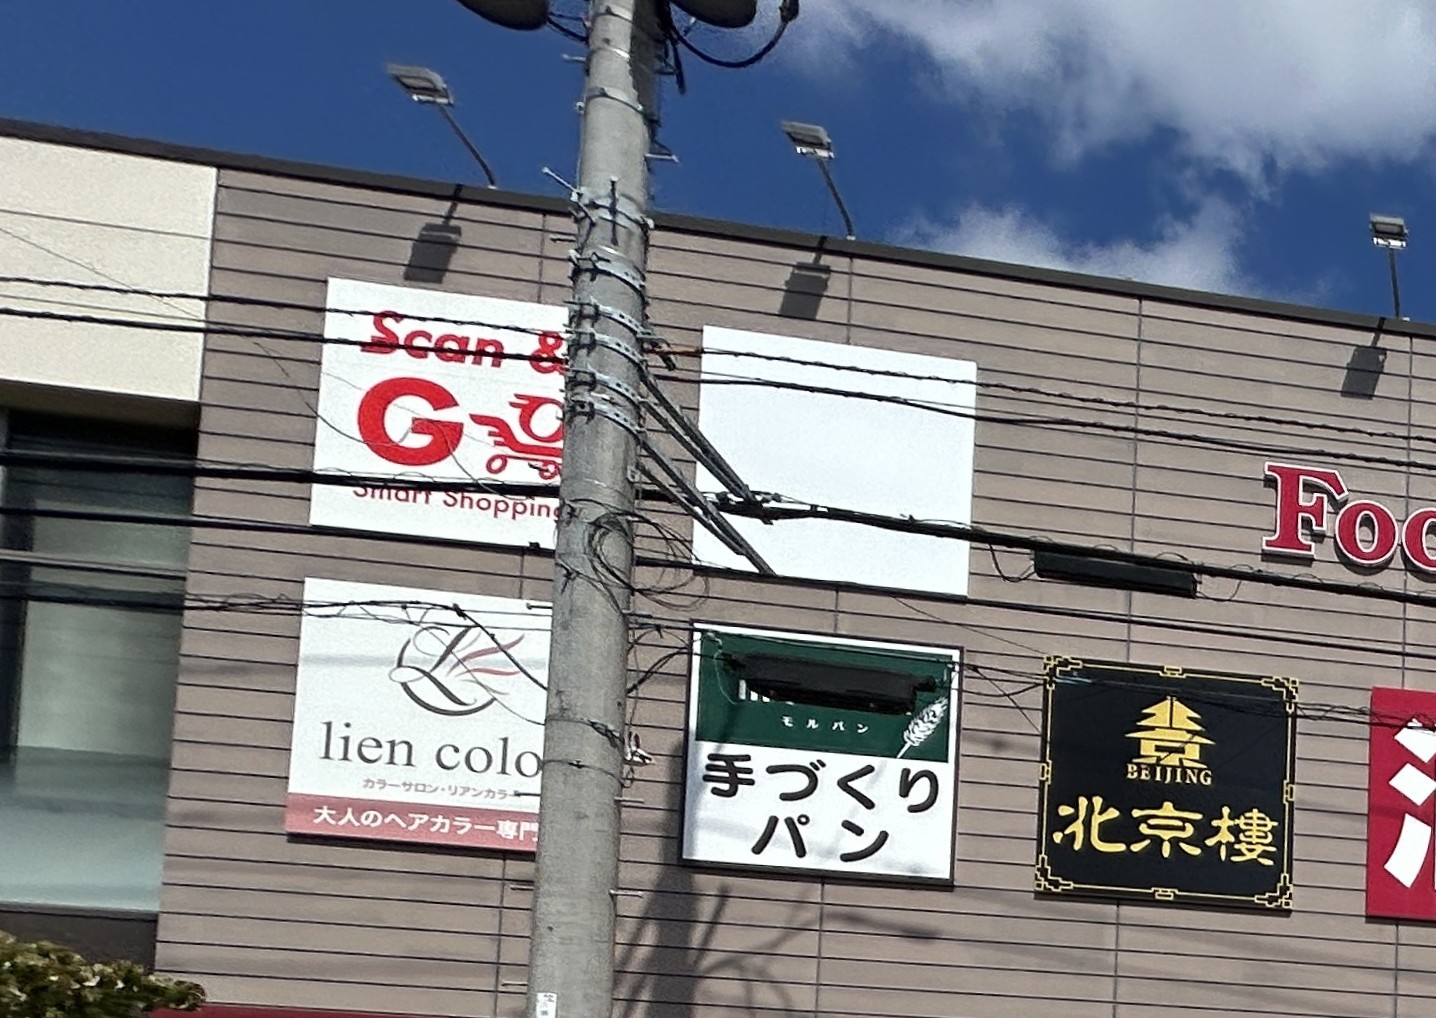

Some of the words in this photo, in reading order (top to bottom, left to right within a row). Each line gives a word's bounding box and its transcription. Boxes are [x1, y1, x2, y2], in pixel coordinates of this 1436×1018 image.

[361, 311, 504, 368] Scan
[319, 720, 416, 768] lien
[702, 752, 939, 813] 手づくり
[1126, 763, 1213, 786] BEIJING
[751, 813, 889, 862] パン
[1052, 796, 1279, 866] 北京樓
